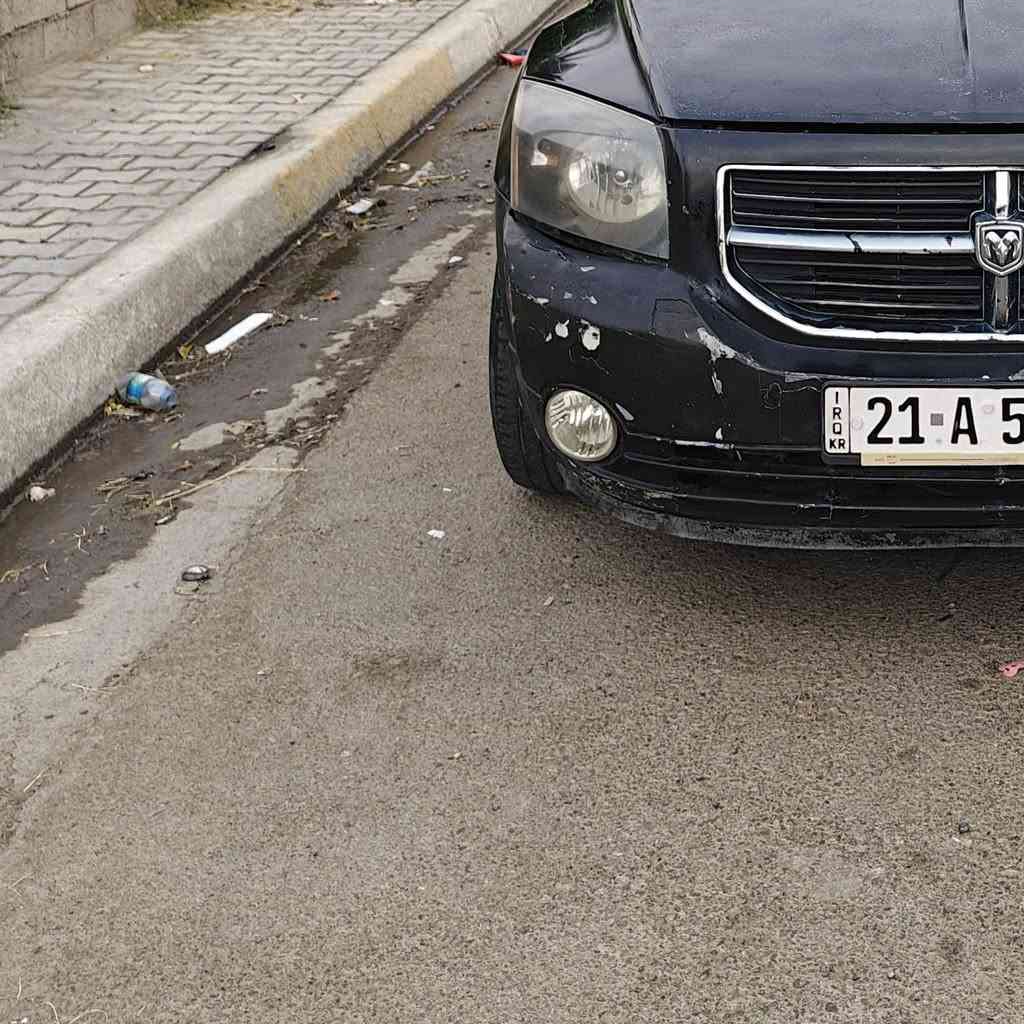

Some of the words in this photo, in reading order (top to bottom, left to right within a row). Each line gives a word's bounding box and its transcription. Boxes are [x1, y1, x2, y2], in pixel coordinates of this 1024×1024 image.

[867, 396, 925, 445] 21
[951, 396, 979, 446] A
[829, 438, 846, 450] KR
